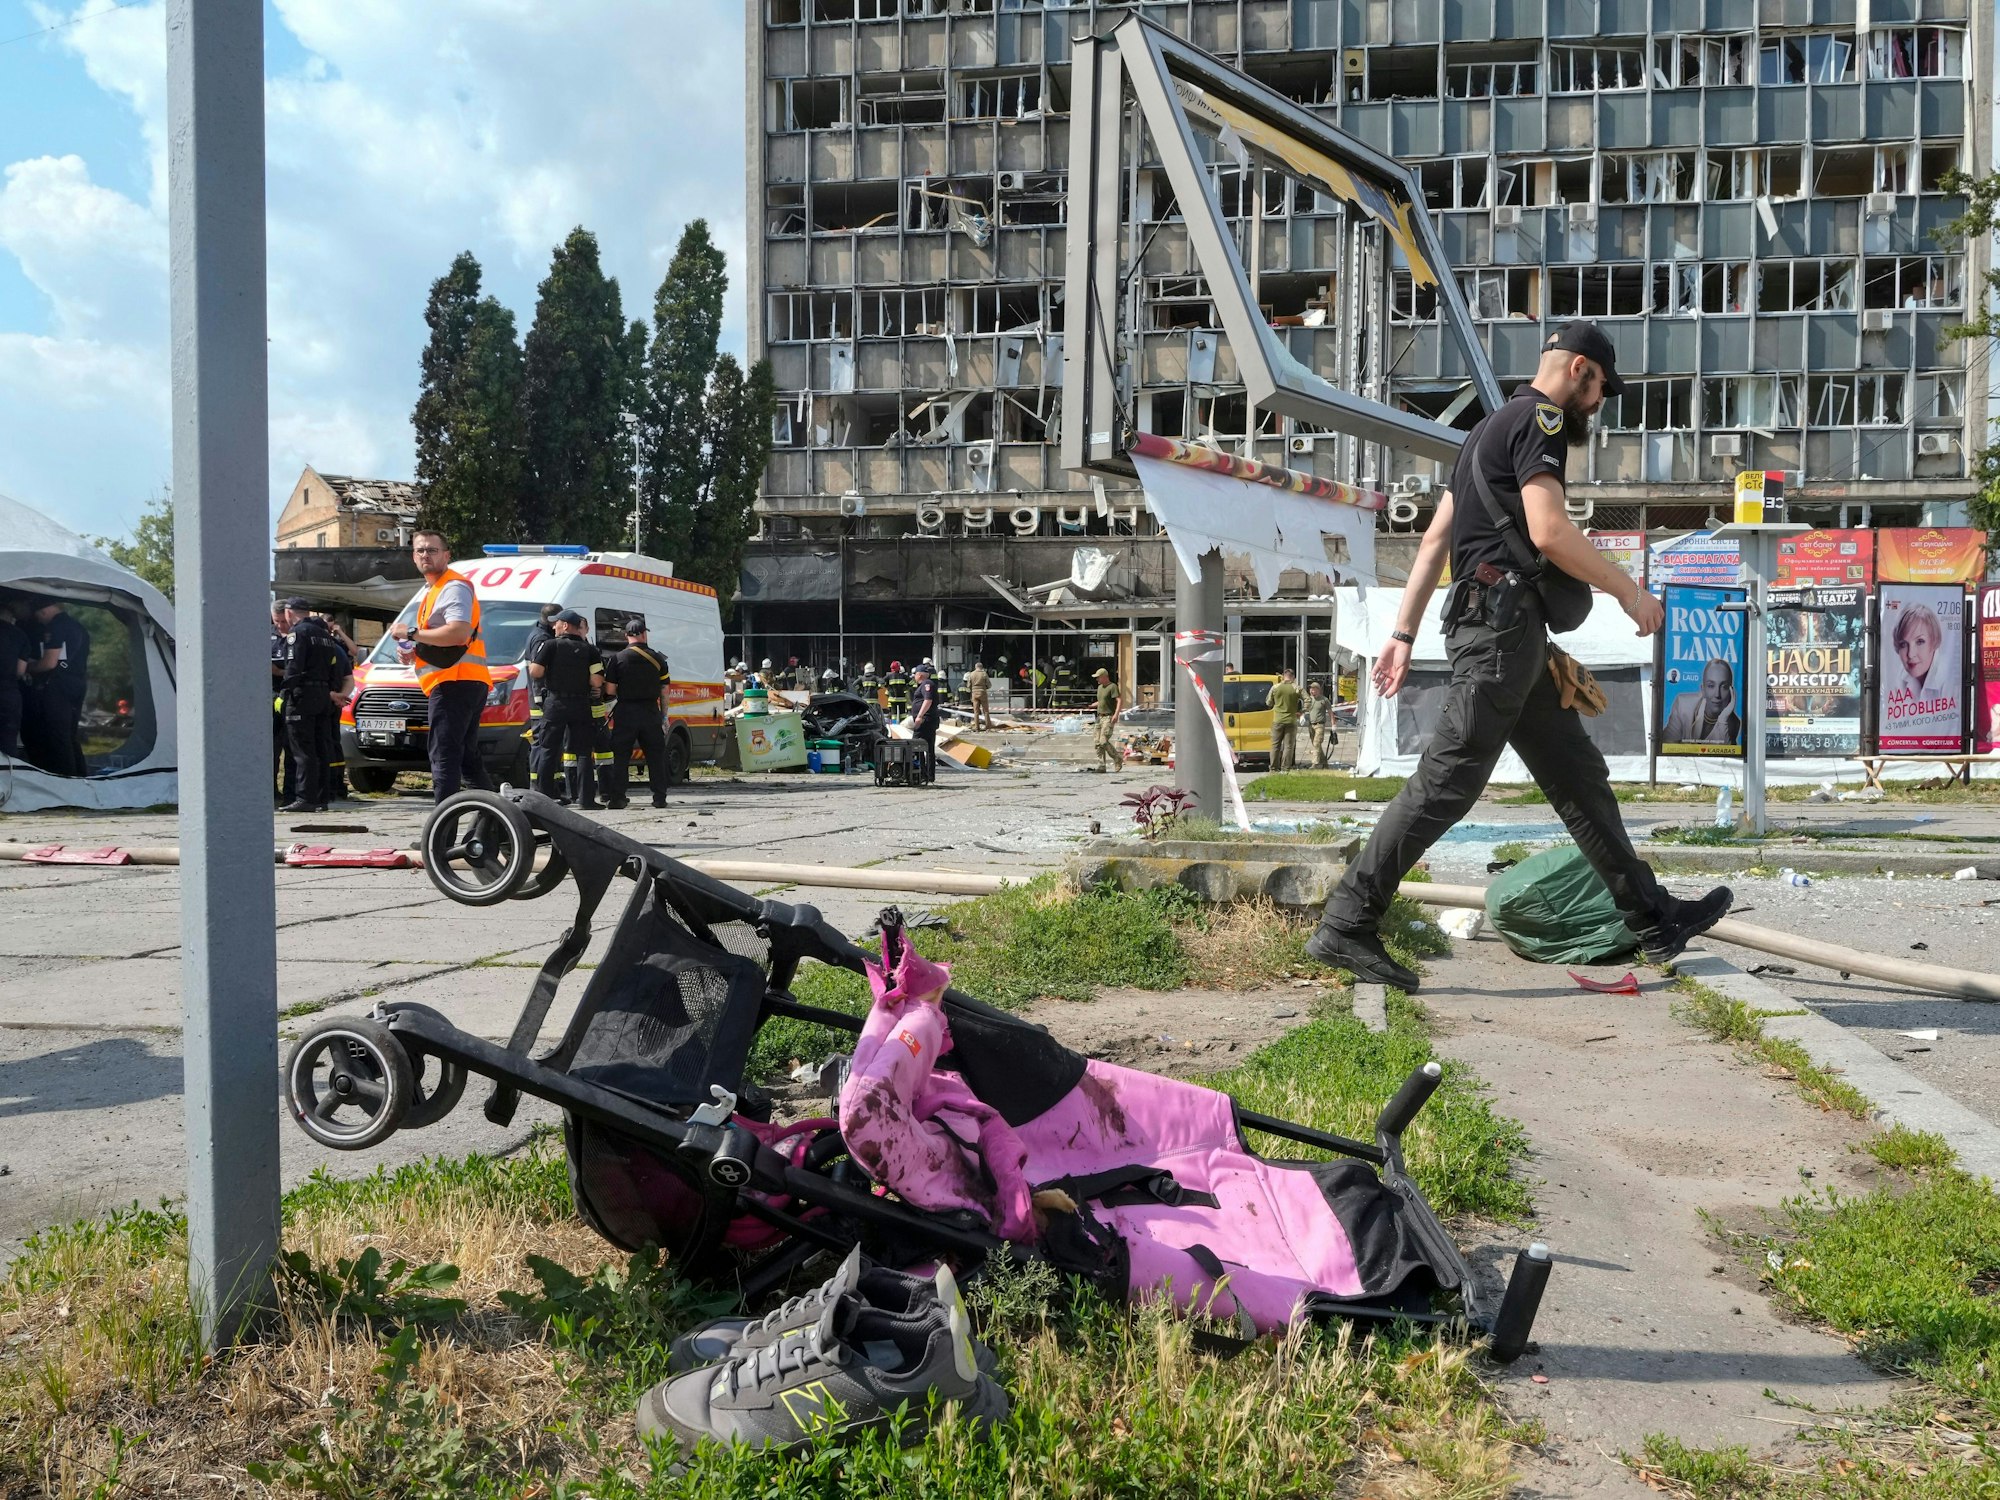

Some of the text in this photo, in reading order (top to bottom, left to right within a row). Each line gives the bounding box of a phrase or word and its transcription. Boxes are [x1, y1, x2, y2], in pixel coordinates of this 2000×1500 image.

[916, 496, 1137, 535] будин
[1615, 538, 1631, 547] БС
[1711, 538, 1740, 546] СИСТЕ
[1663, 554, 1740, 565] ВІДЕОНАГЛЯД
[1817, 594, 1857, 602] ТЕАТРУ
[1937, 601, 1961, 615] 27.06
[1671, 607, 1740, 636] ROXO
[1672, 635, 1738, 663] LANA
[1767, 649, 1851, 674] НАОНІ
[1767, 674, 1851, 687] ОРКЕСТРА
[669, 689, 684, 698] ЛЬНА
[1888, 687, 1913, 704] АДА
[1888, 697, 1956, 720] РОГОВЦЕВА
[374, 721, 388, 729] 797
[1912, 716, 1931, 726] КОГО
